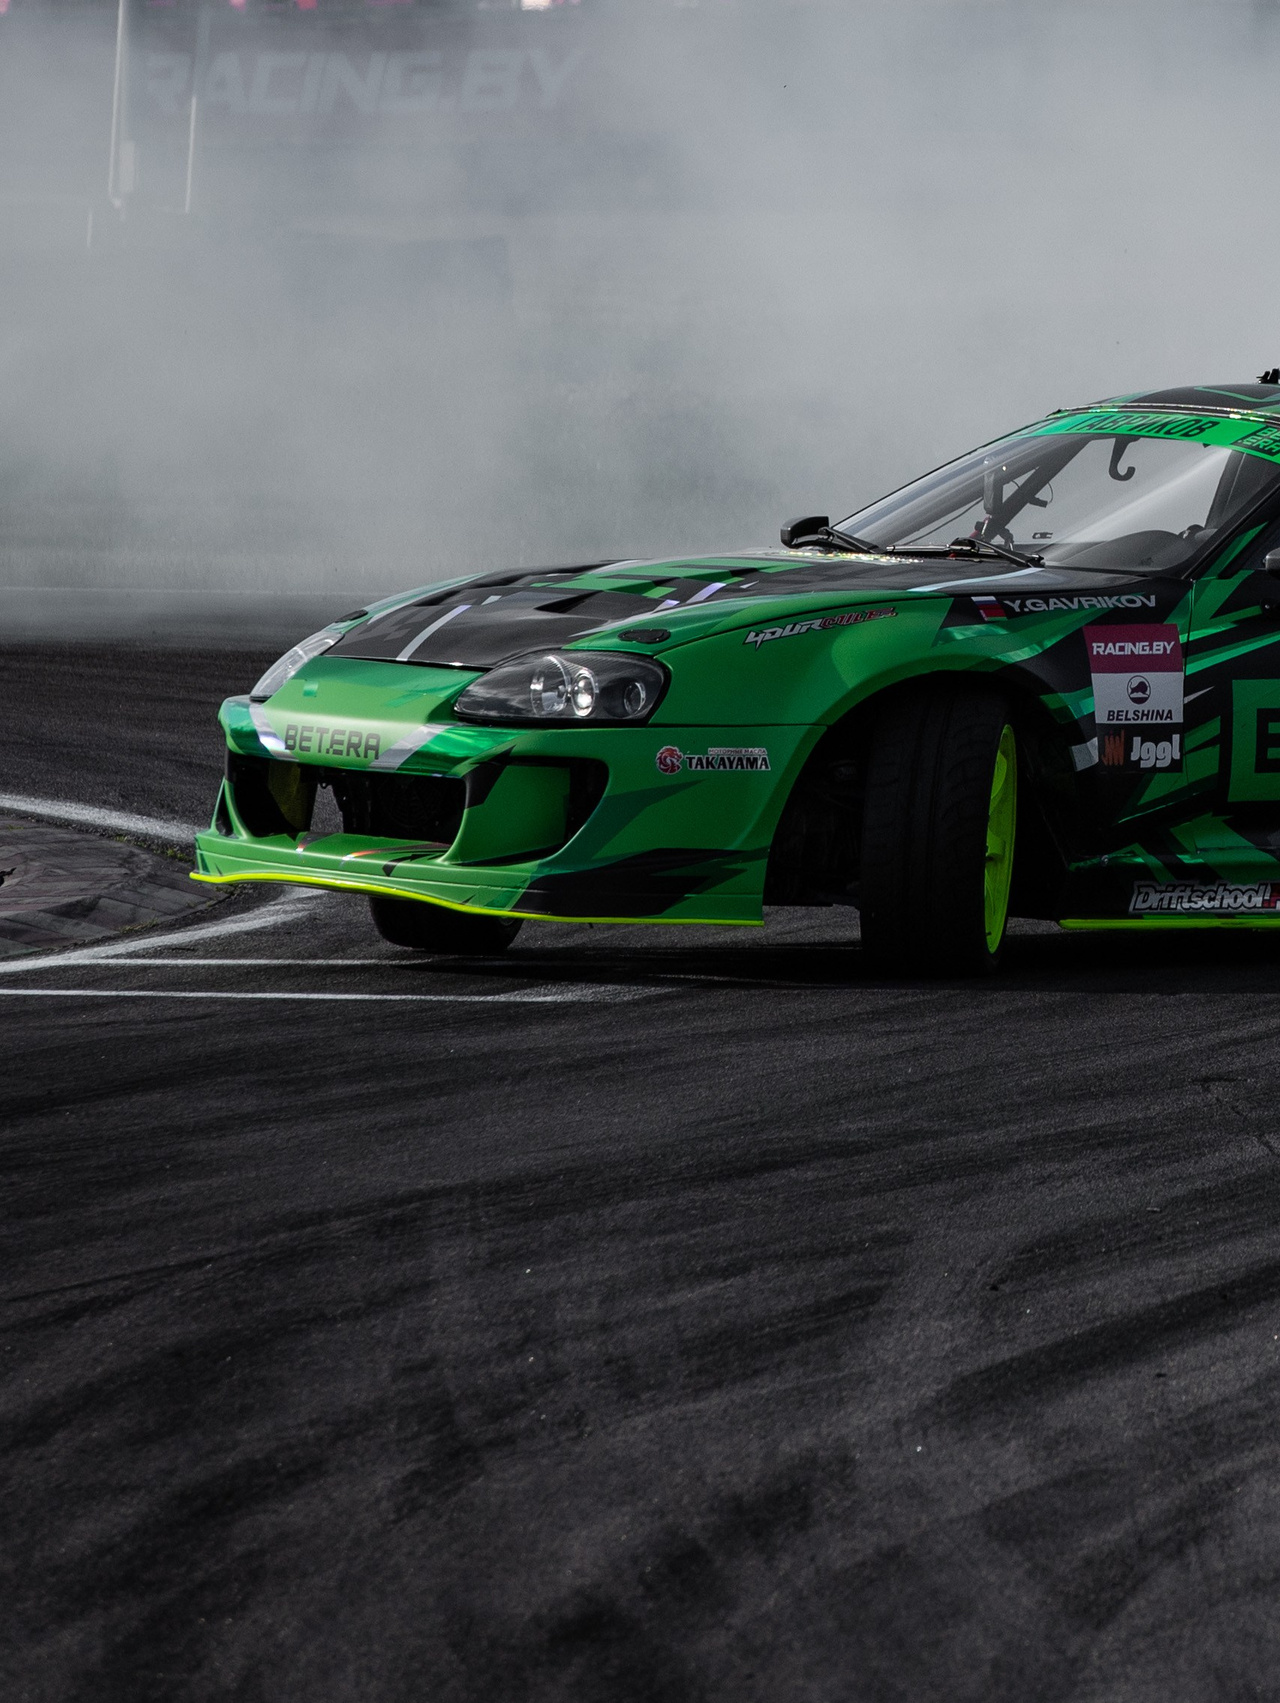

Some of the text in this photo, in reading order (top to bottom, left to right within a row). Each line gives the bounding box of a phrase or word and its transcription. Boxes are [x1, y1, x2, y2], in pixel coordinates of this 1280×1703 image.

[143, 48, 588, 115] RACING.BY
[1067, 413, 1221, 438] ГАВРИКОВ
[1003, 594, 1157, 613] Y.GAVRIKOV
[1091, 640, 1176, 656] RACING.BY
[1106, 708, 1174, 722] BELSHINA
[686, 756, 770, 770] TAKAYAMA
